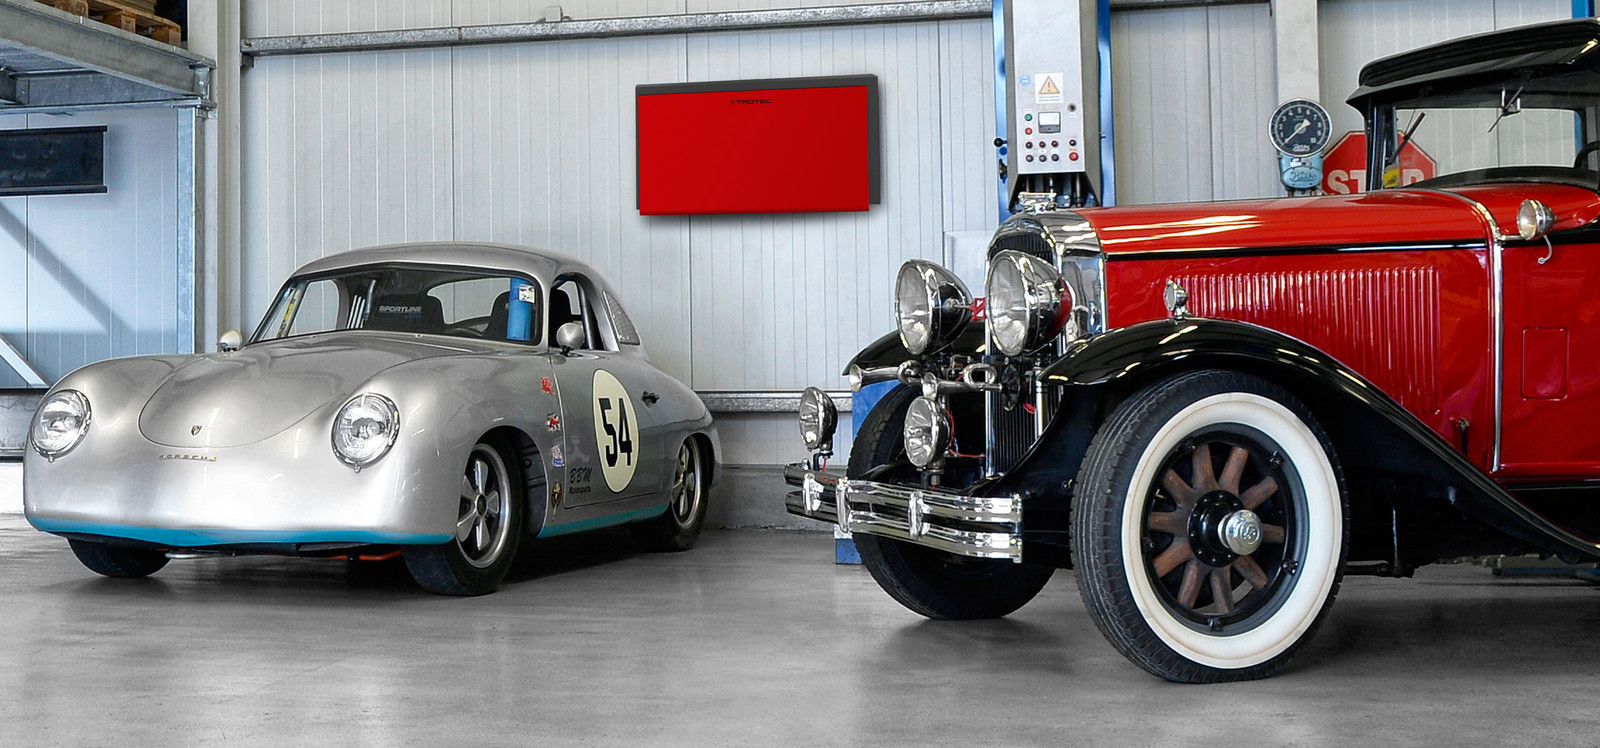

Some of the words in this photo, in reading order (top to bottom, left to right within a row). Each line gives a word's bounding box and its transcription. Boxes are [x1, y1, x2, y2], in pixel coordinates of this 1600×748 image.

[379, 305, 422, 313] SPORTLINE
[598, 398, 633, 467] 54
[569, 467, 593, 484] BBM
